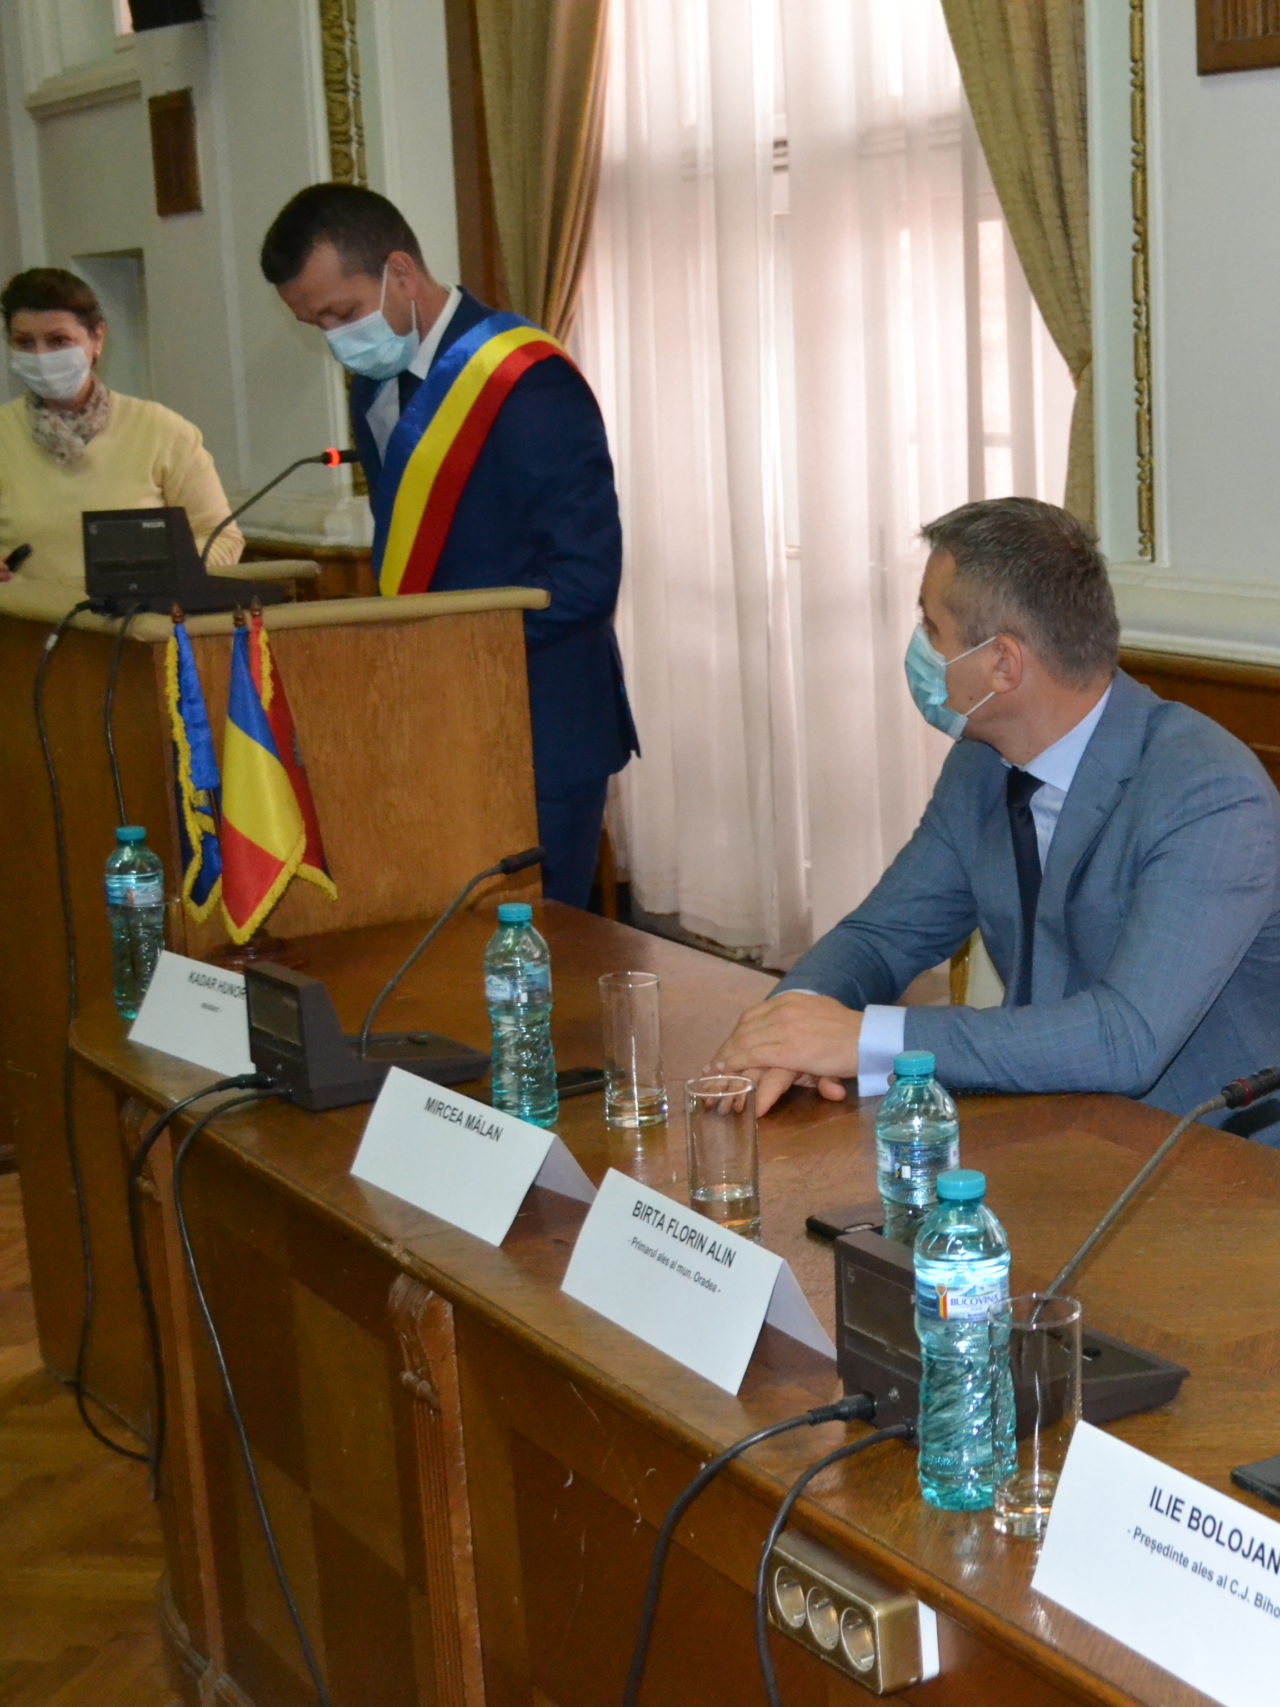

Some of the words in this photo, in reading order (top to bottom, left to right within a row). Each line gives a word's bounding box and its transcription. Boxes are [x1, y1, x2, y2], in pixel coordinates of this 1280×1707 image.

[424, 1097, 465, 1126] MIRCEA
[632, 1200, 666, 1232] BIRTA
[666, 1218, 708, 1254] FLORIN
[706, 1240, 736, 1268] ALIN
[693, 1271, 718, 1293] Oradea
[950, 1293, 999, 1306] BUCOVINA
[1149, 1485, 1185, 1523] ILIE
[1191, 1560, 1214, 1582] ales
[1216, 1575, 1228, 1589] al
[1229, 1579, 1250, 1603] C.J.
